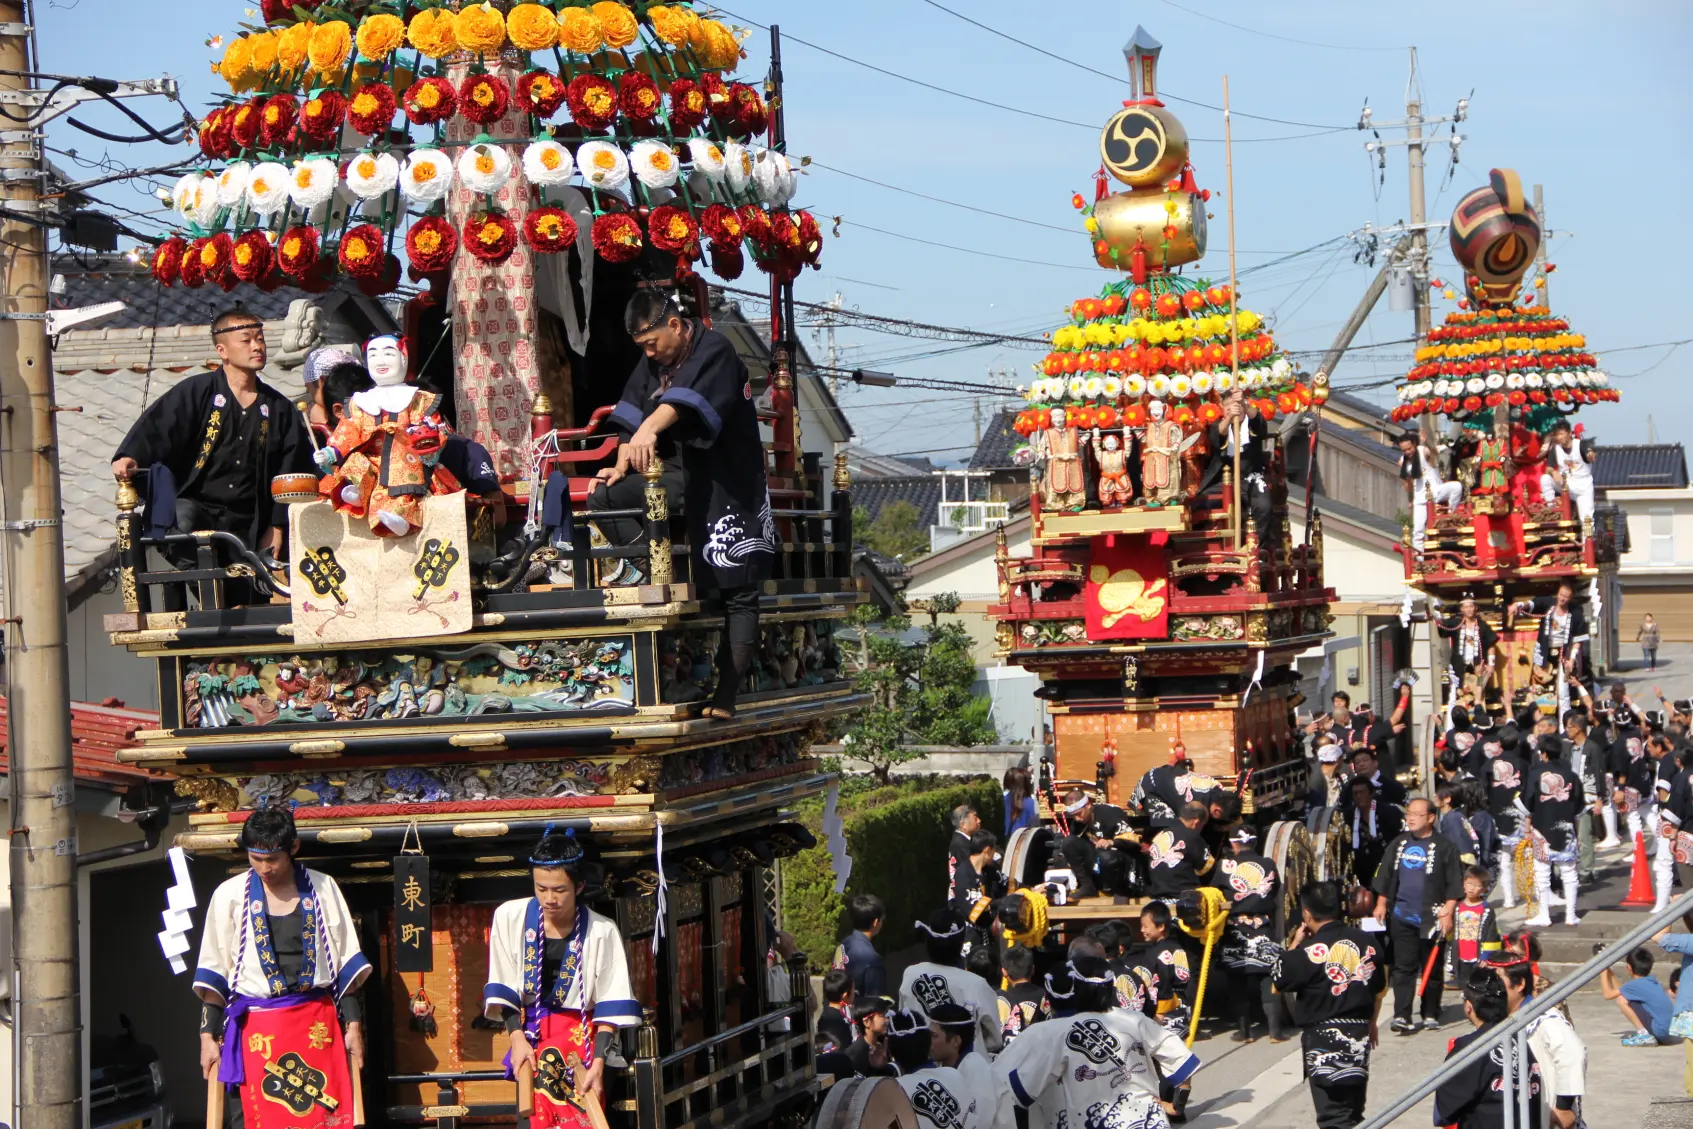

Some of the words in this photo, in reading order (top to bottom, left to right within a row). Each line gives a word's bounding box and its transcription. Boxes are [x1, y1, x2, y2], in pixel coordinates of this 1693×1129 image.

[401, 875, 425, 949] 東町
[296, 1067, 317, 1083] 天下
[282, 1087, 304, 1103] 太平
